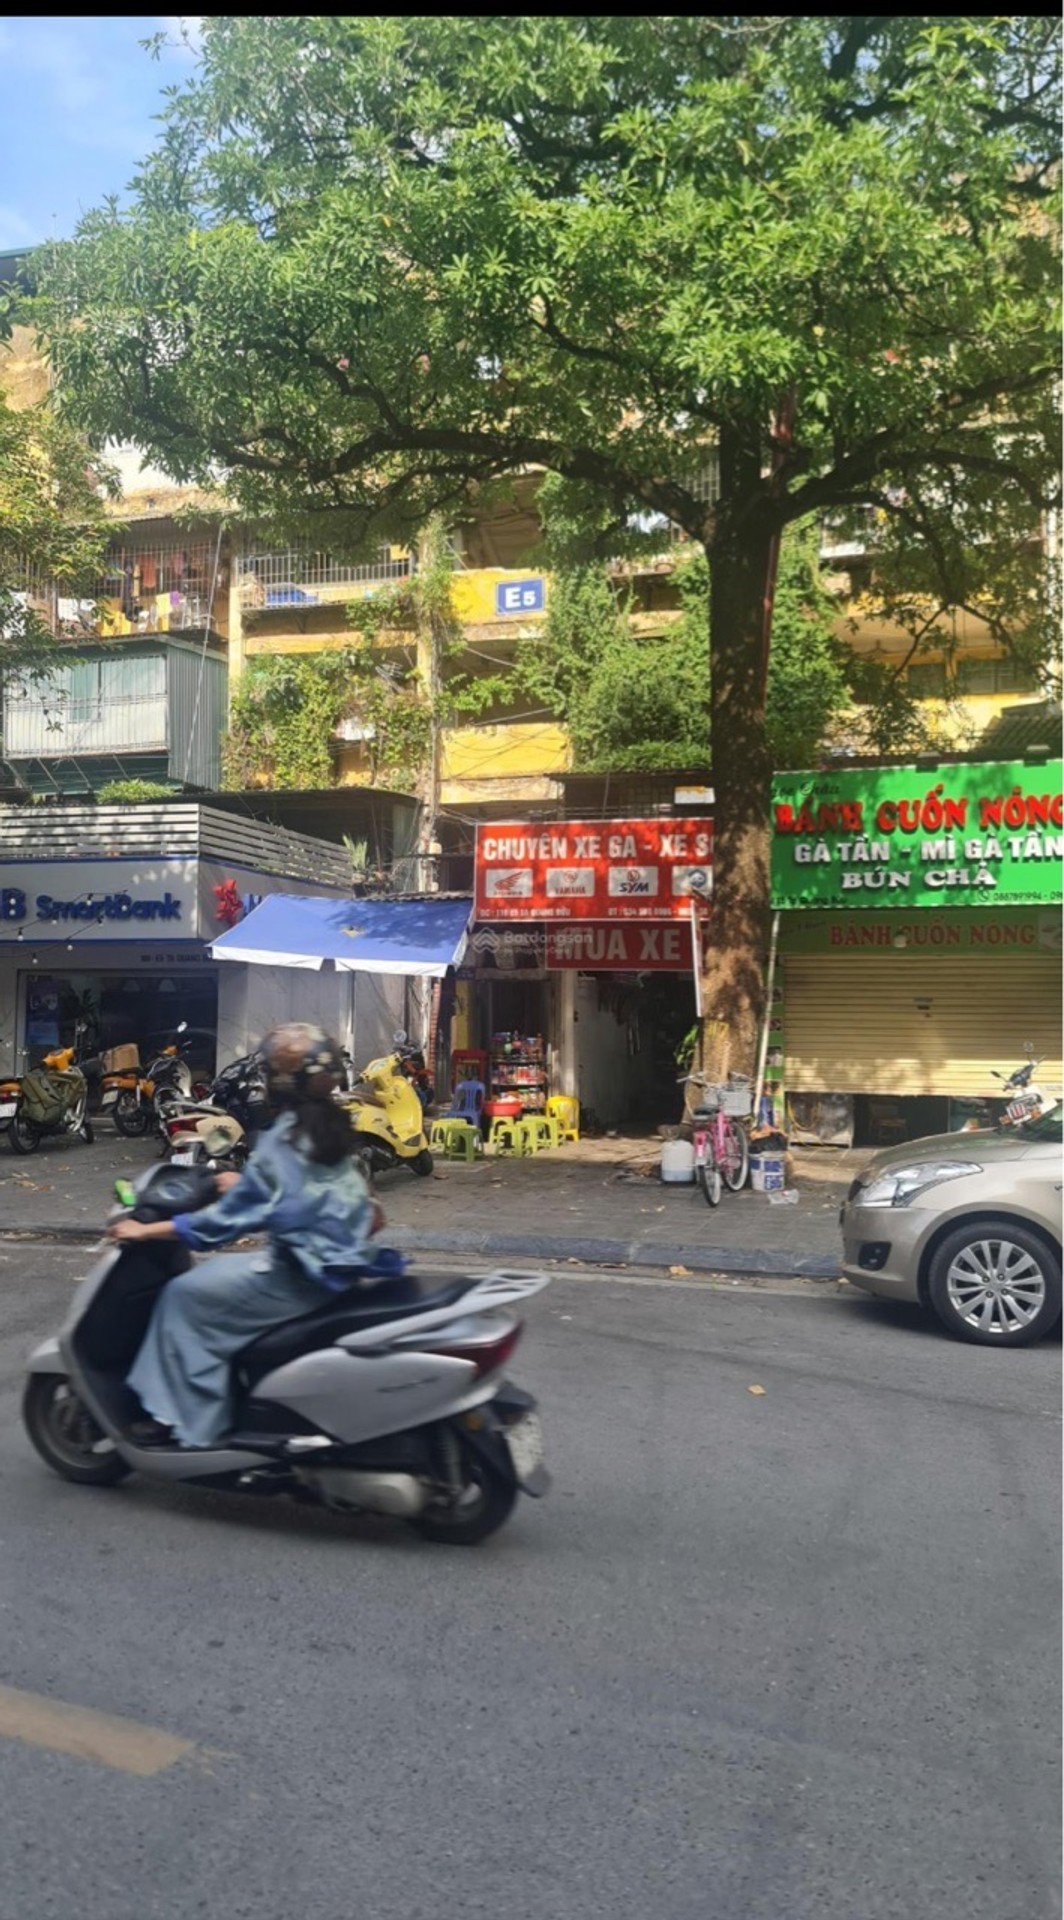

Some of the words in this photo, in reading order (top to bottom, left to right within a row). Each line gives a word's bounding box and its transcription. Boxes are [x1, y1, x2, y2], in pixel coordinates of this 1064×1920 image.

[504, 586, 537, 609] E5
[775, 795, 863, 833] BÁNH
[875, 783, 967, 834] CUỐN
[483, 832, 568, 860] CHUYÊN
[573, 835, 602, 859] XE
[608, 835, 637, 858] GA
[659, 834, 689, 857] XE
[794, 837, 831, 863] GÀ
[920, 834, 956, 861] MÌ
[964, 830, 1003, 860] GÀ
[619, 881, 649, 893] SYM
[841, 865, 912, 889] BÚN
[924, 861, 998, 887] CHẢ
[36, 892, 182, 921] SmartBank
[555, 928, 628, 960] MUA
[640, 928, 681, 960] XE
[830, 919, 891, 946] BÁNH
[970, 919, 1036, 945] NÓNG
